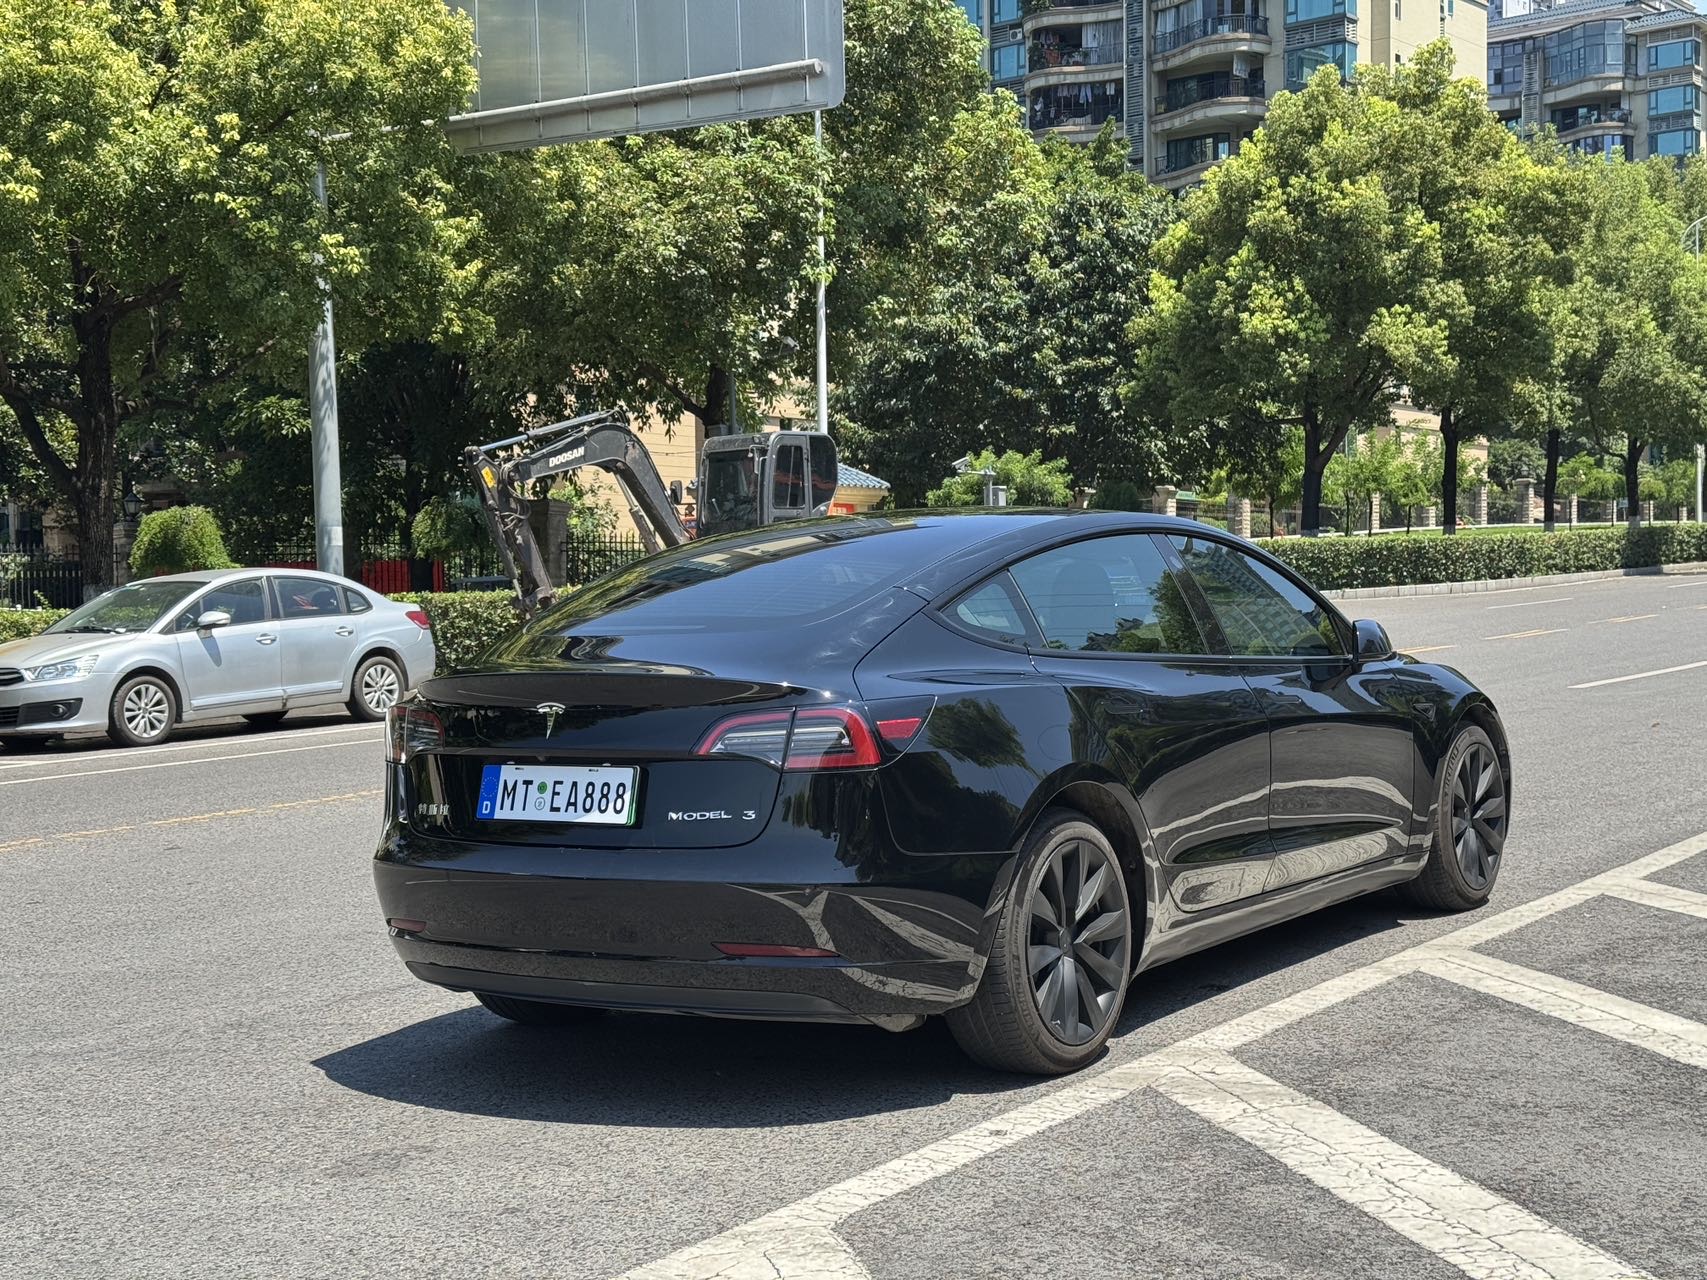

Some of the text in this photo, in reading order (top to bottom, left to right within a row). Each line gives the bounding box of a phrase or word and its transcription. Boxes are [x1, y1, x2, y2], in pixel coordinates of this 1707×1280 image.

[549, 446, 585, 467] DOOSAN
[500, 779, 626, 814] MT EA888
[482, 801, 491, 813] D
[668, 810, 756, 820] MODEL 3
